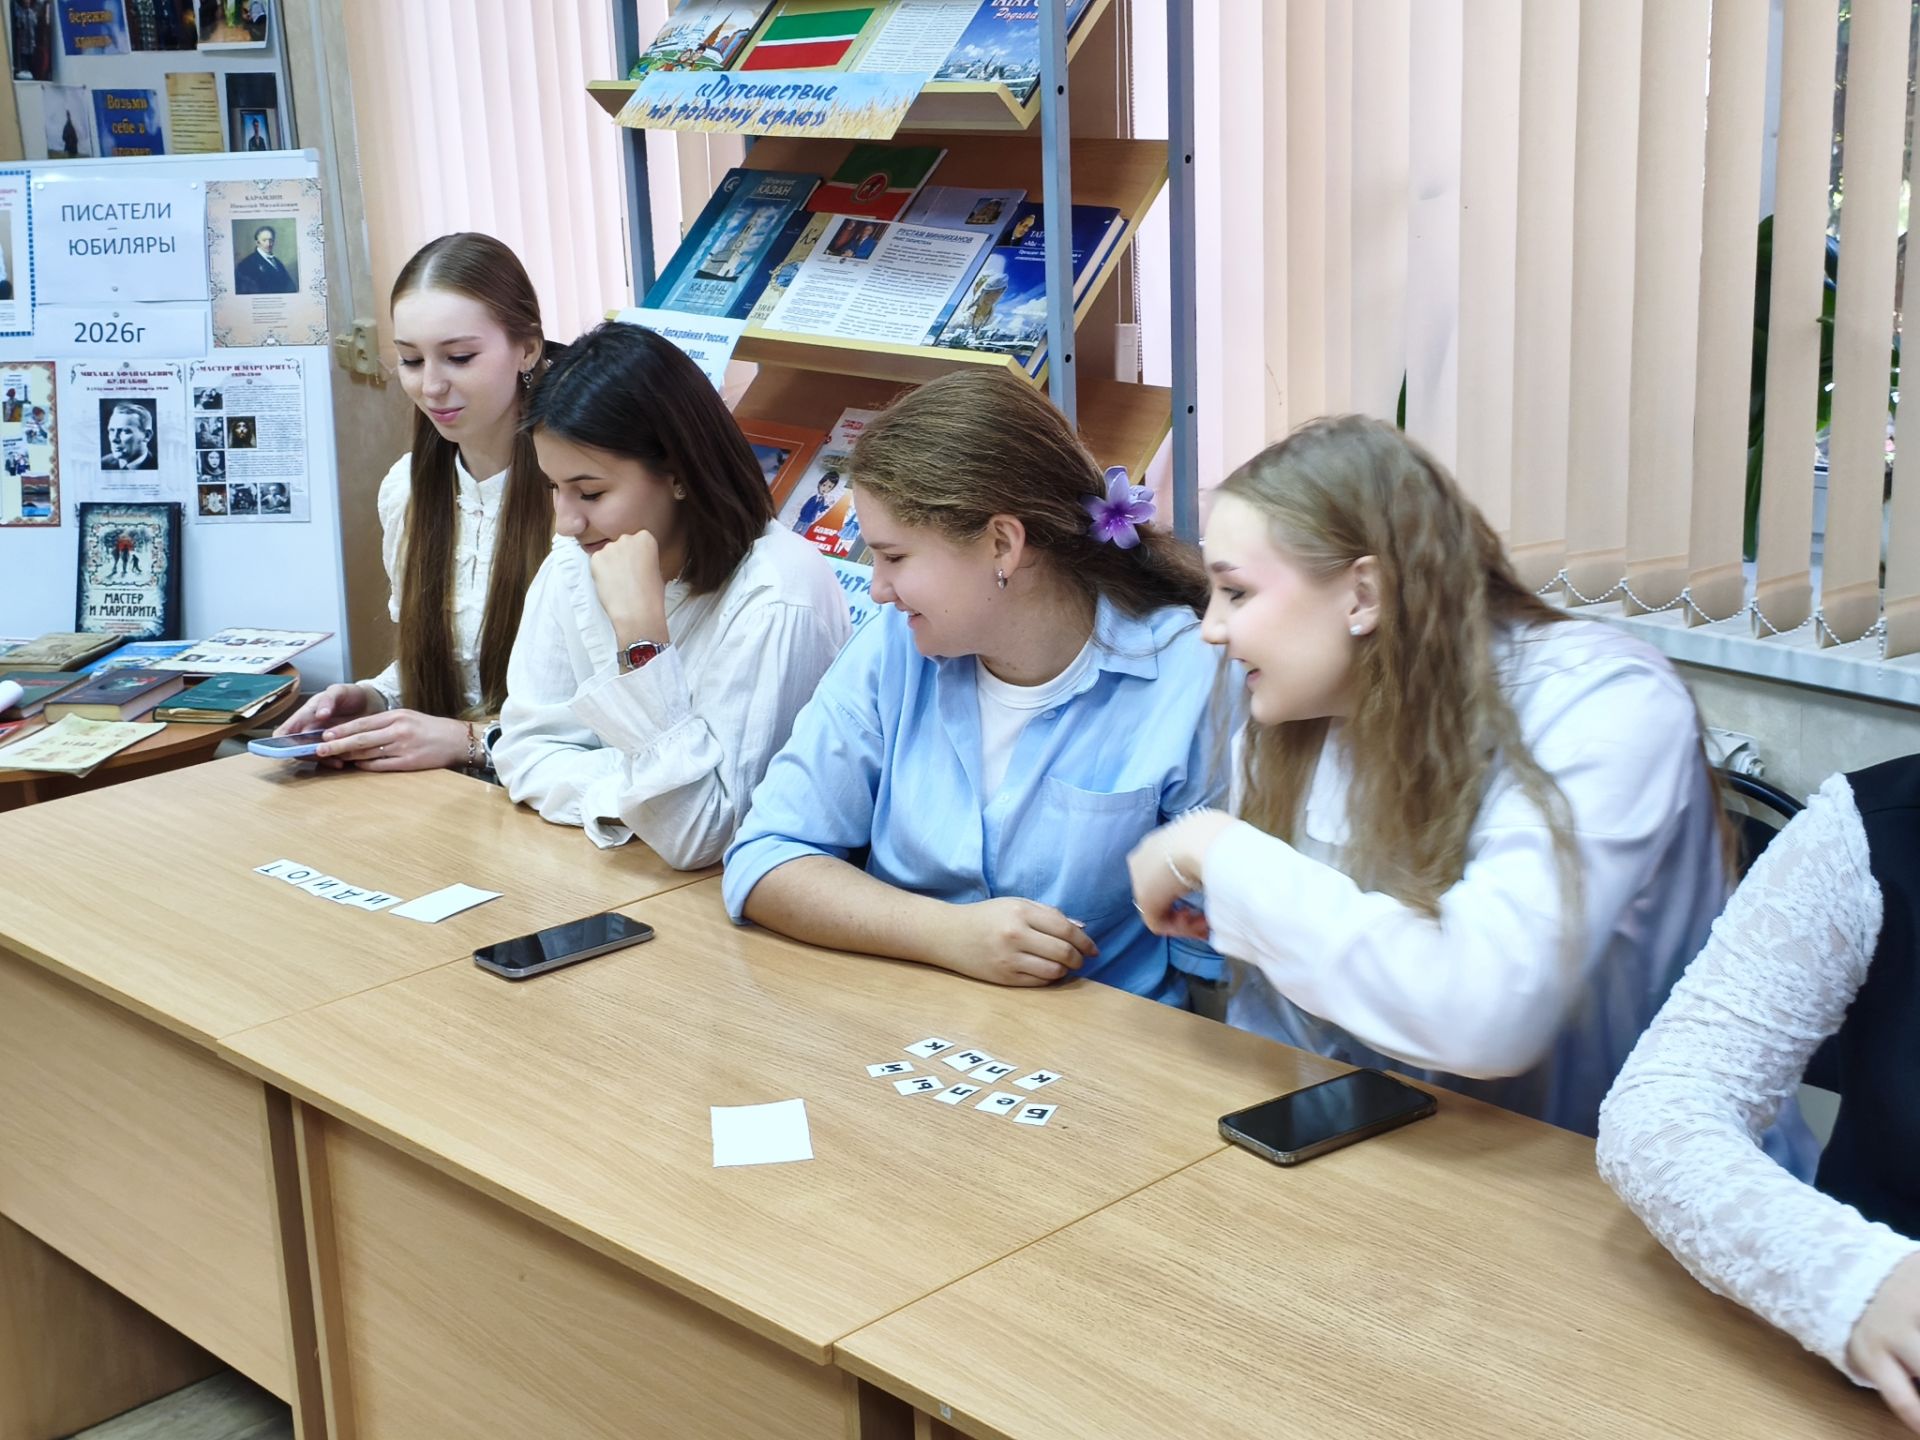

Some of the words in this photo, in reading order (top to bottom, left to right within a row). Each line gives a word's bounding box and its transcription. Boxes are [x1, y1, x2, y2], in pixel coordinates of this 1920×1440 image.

[695, 73, 838, 104] «Путешествие
[669, 99, 757, 128] родному
[61, 202, 171, 222] ПИСАТЕЛИ
[68, 236, 176, 256] ЮБИЛЯРЫ
[689, 282, 727, 296] КАЗАНЬ
[74, 321, 146, 343] 2026г
[104, 593, 144, 605] МАСТЕР
[89, 605, 96, 616] И
[99, 605, 157, 617] МАРГАРИТА
[260, 864, 390, 905] ИДИОТ
